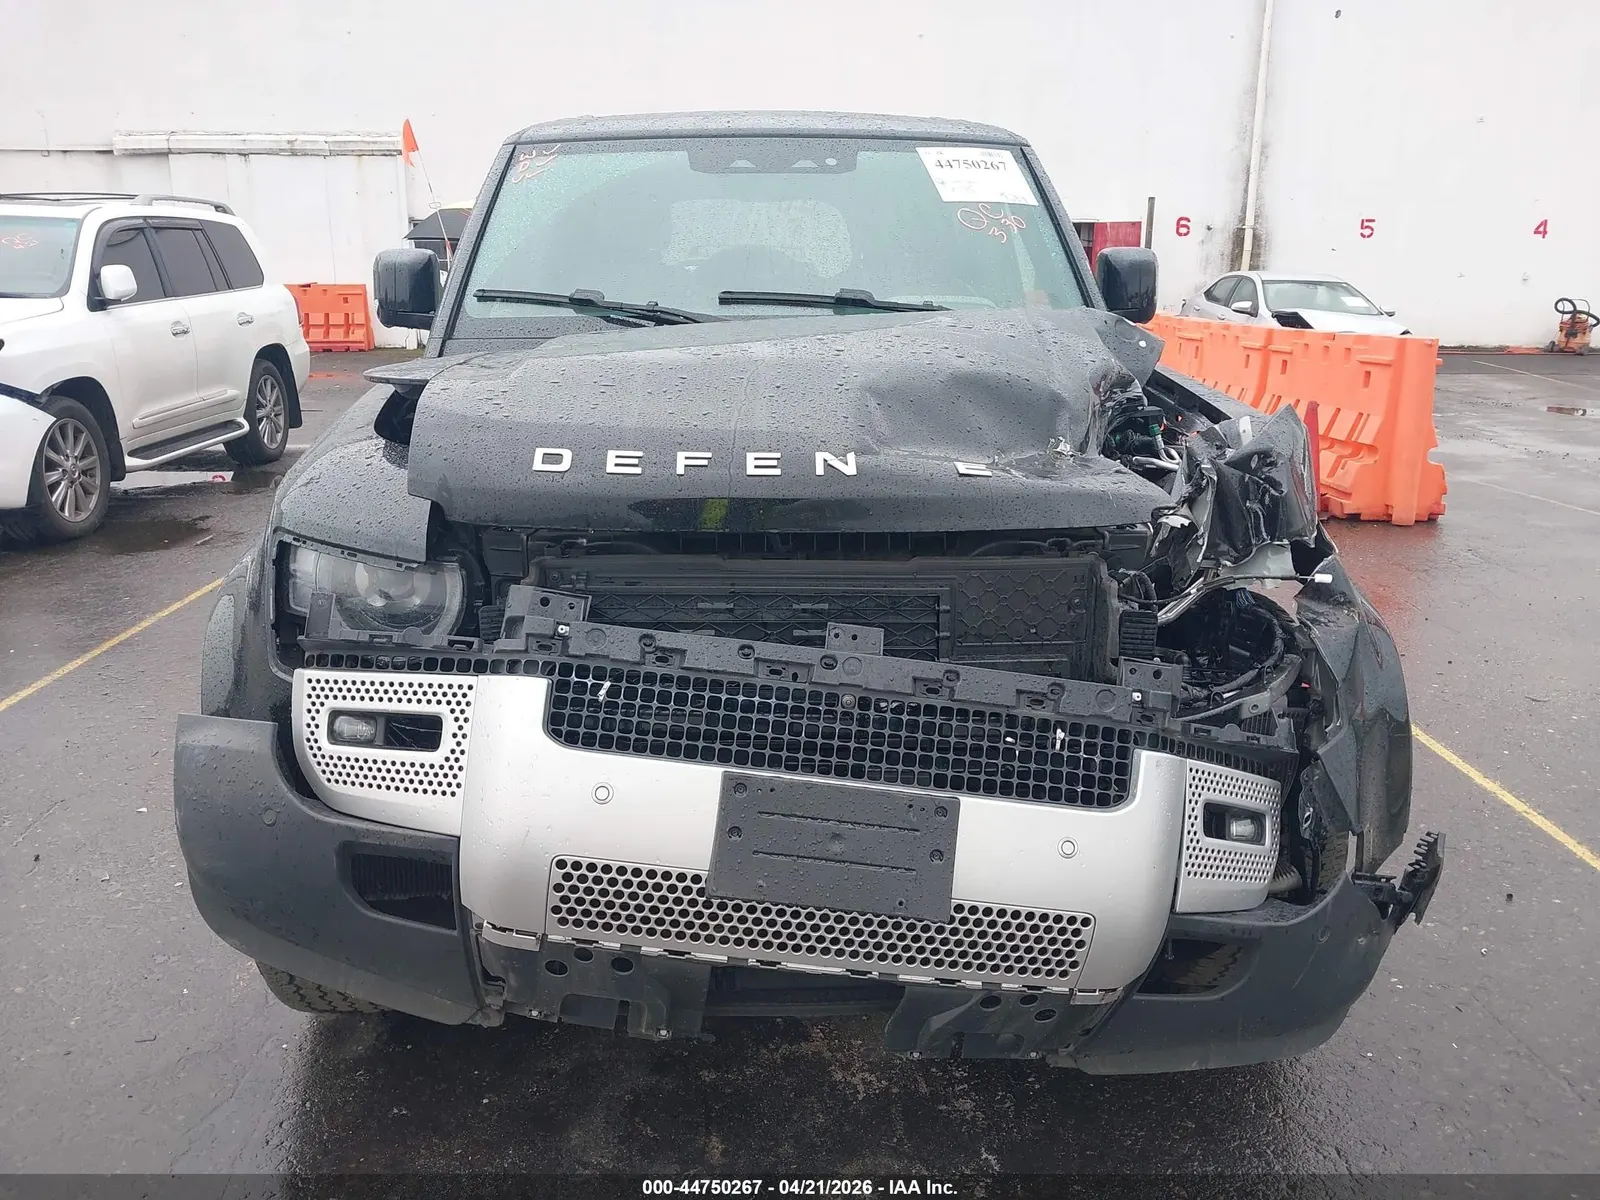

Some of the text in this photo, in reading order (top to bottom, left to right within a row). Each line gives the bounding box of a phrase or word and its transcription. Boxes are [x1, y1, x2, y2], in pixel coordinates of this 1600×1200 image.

[935, 159, 1007, 172] 44750267
[1175, 216, 1192, 237] 6
[1360, 218, 1376, 239] 5
[1533, 219, 1549, 239] 4
